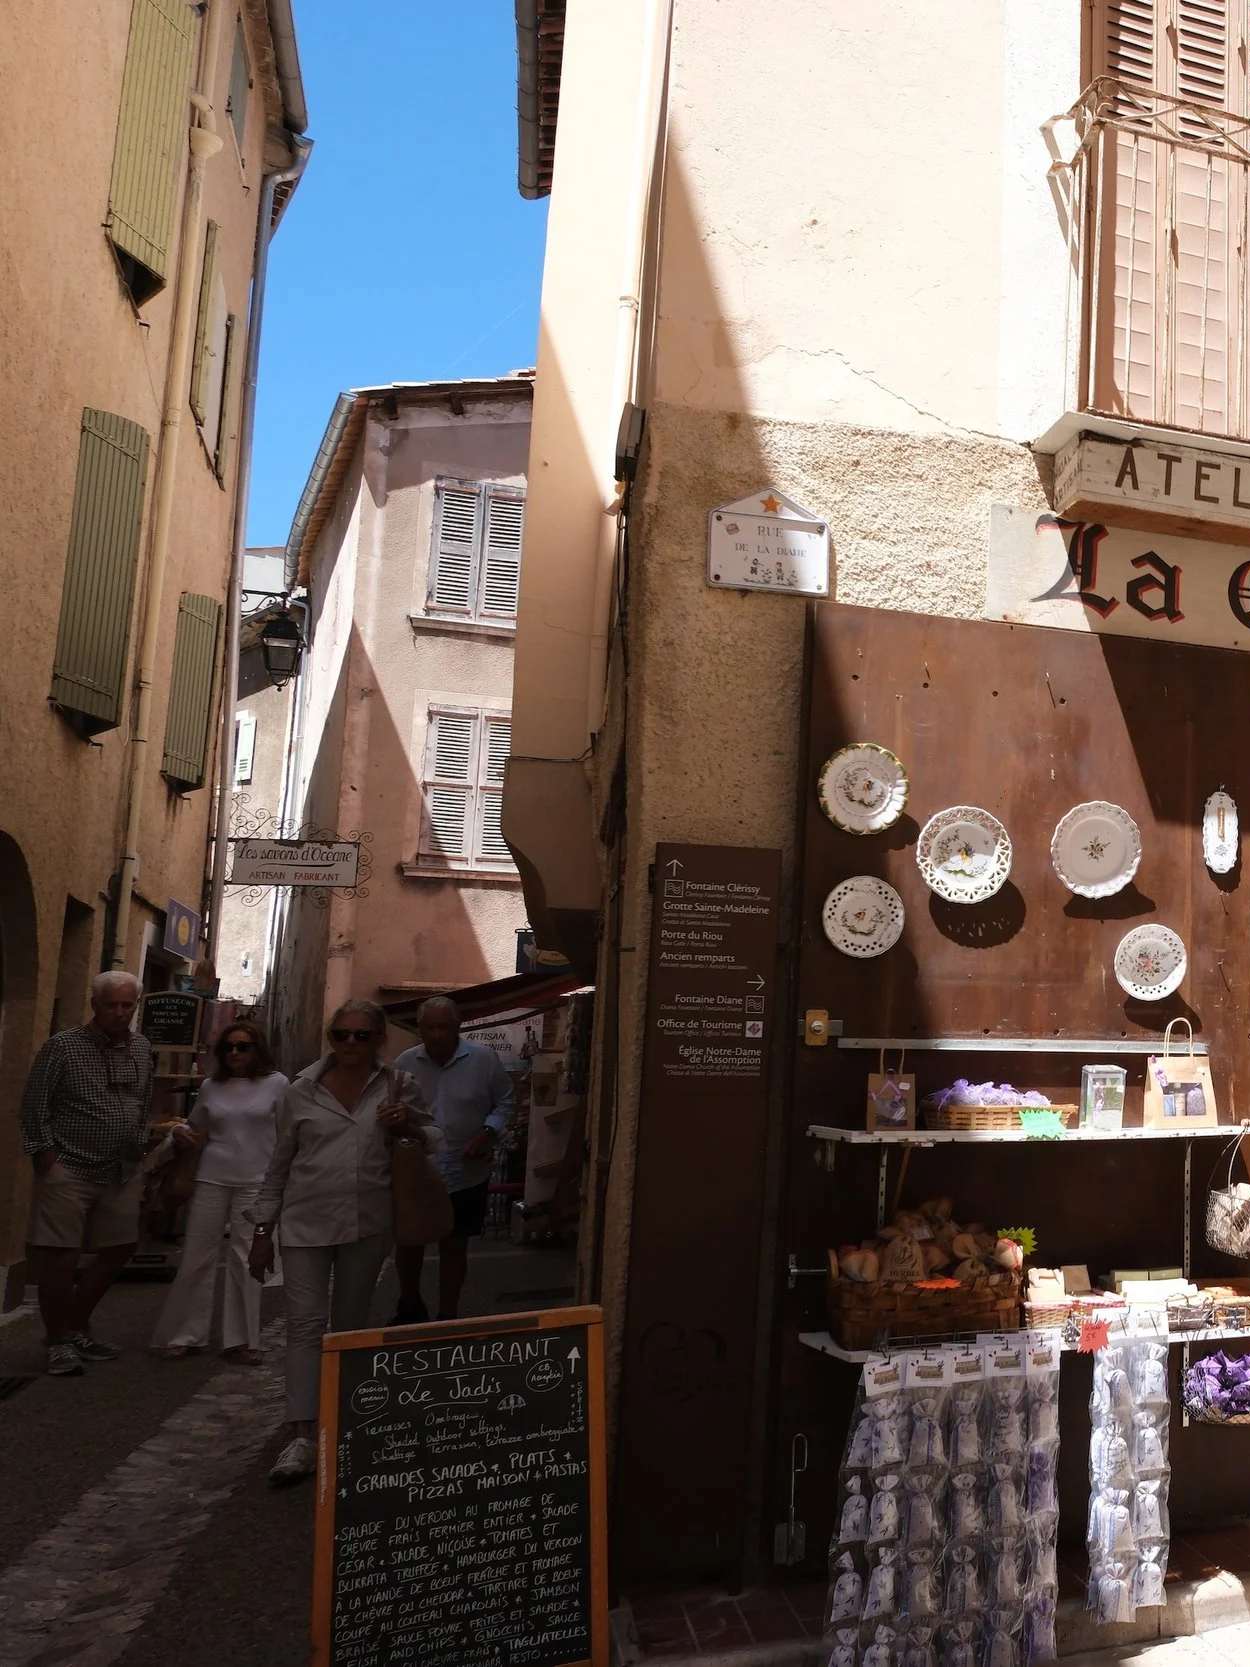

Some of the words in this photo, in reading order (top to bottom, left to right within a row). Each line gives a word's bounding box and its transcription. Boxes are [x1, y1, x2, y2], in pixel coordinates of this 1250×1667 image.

[757, 526, 784, 538] RUE
[735, 543, 749, 552] DE
[757, 546, 770, 554] LA
[1031, 513, 1185, 624] La
[238, 844, 258, 859] Les
[260, 850, 299, 860] savons
[248, 871, 286, 880] ARTISAN
[293, 872, 341, 881] FABRICANT
[686, 881, 725, 892] Fontaine
[727, 883, 761, 895] Clérissy
[663, 901, 693, 911] Grotte
[694, 902, 770, 915] Sainte-Madeleine
[661, 929, 686, 940] Porte
[688, 930, 700, 940] du
[702, 931, 723, 941] Riou
[660, 951, 692, 961] Ancien
[694, 953, 736, 963] remparts
[147, 998, 196, 1007] DIFFUSEURS
[675, 994, 715, 1004] Fontaine
[717, 995, 743, 1005] Diane
[154, 1017, 184, 1025] GRASSE
[657, 1019, 685, 1028] Office
[687, 1019, 699, 1028] de
[701, 1019, 743, 1030] Tourisme
[466, 1032, 506, 1041] ARTISAN
[679, 1044, 704, 1057] Église
[706, 1047, 762, 1056] Notre-Dame
[690, 1055, 701, 1063] de
[704, 1055, 761, 1065] l'Assomption
[373, 1336, 560, 1378] RESTAURANT
[398, 1379, 434, 1406] Le
[445, 1374, 502, 1399] Jadis
[385, 1432, 420, 1450] Shaded
[426, 1428, 463, 1443] outdoor
[356, 1468, 425, 1494] GRANDES
[432, 1461, 487, 1483] SALADES
[508, 1449, 556, 1470] PLATS
[408, 1481, 464, 1504] PIZZAS
[477, 1470, 530, 1491] MAISON
[544, 1460, 588, 1479] PASTAS
[340, 1520, 386, 1542] SALADE
[395, 1515, 411, 1532] DU
[414, 1507, 457, 1529] VERDON
[465, 1504, 478, 1518] AU
[488, 1496, 533, 1514] FROMAGE
[541, 1493, 556, 1506] DE
[389, 1528, 420, 1546] FRAIS
[429, 1520, 475, 1540] FERMIER
[483, 1511, 525, 1529] ENTIER
[542, 1502, 579, 1520] SALADE
[337, 1553, 375, 1576] CÉSAR
[390, 1545, 429, 1565] SALADE
[486, 1526, 533, 1545] TOMATES
[542, 1522, 561, 1538] ET
[336, 1570, 387, 1594] BURRATA
[456, 1548, 517, 1569] HAMBURGER
[543, 1534, 583, 1551] VERDON
[349, 1596, 362, 1609] LA
[366, 1586, 404, 1606] VIANDE
[410, 1583, 425, 1595] DE
[514, 1561, 527, 1575] ET
[532, 1553, 573, 1572] FROMAGE
[335, 1615, 349, 1629] DE
[398, 1602, 414, 1614] OU
[419, 1588, 465, 1610] CHEDDAR
[479, 1577, 528, 1596] TARTARE
[534, 1573, 547, 1586] DE
[380, 1619, 393, 1632] AU
[397, 1607, 443, 1628] COUTEAU
[450, 1594, 509, 1615] CHAROLAIS
[530, 1582, 581, 1601] JAMBON
[388, 1631, 424, 1647] SAUCE
[428, 1622, 464, 1639] POIVRE
[469, 1612, 505, 1628] FRITES
[509, 1609, 523, 1621] ET
[529, 1600, 569, 1617] SALADE
[390, 1647, 414, 1661] AND
[418, 1635, 457, 1654] CHIPS
[546, 1612, 581, 1628] SAUCE
[504, 1626, 588, 1651] TAGLIATELLES
[509, 1649, 541, 1665] PESTO
